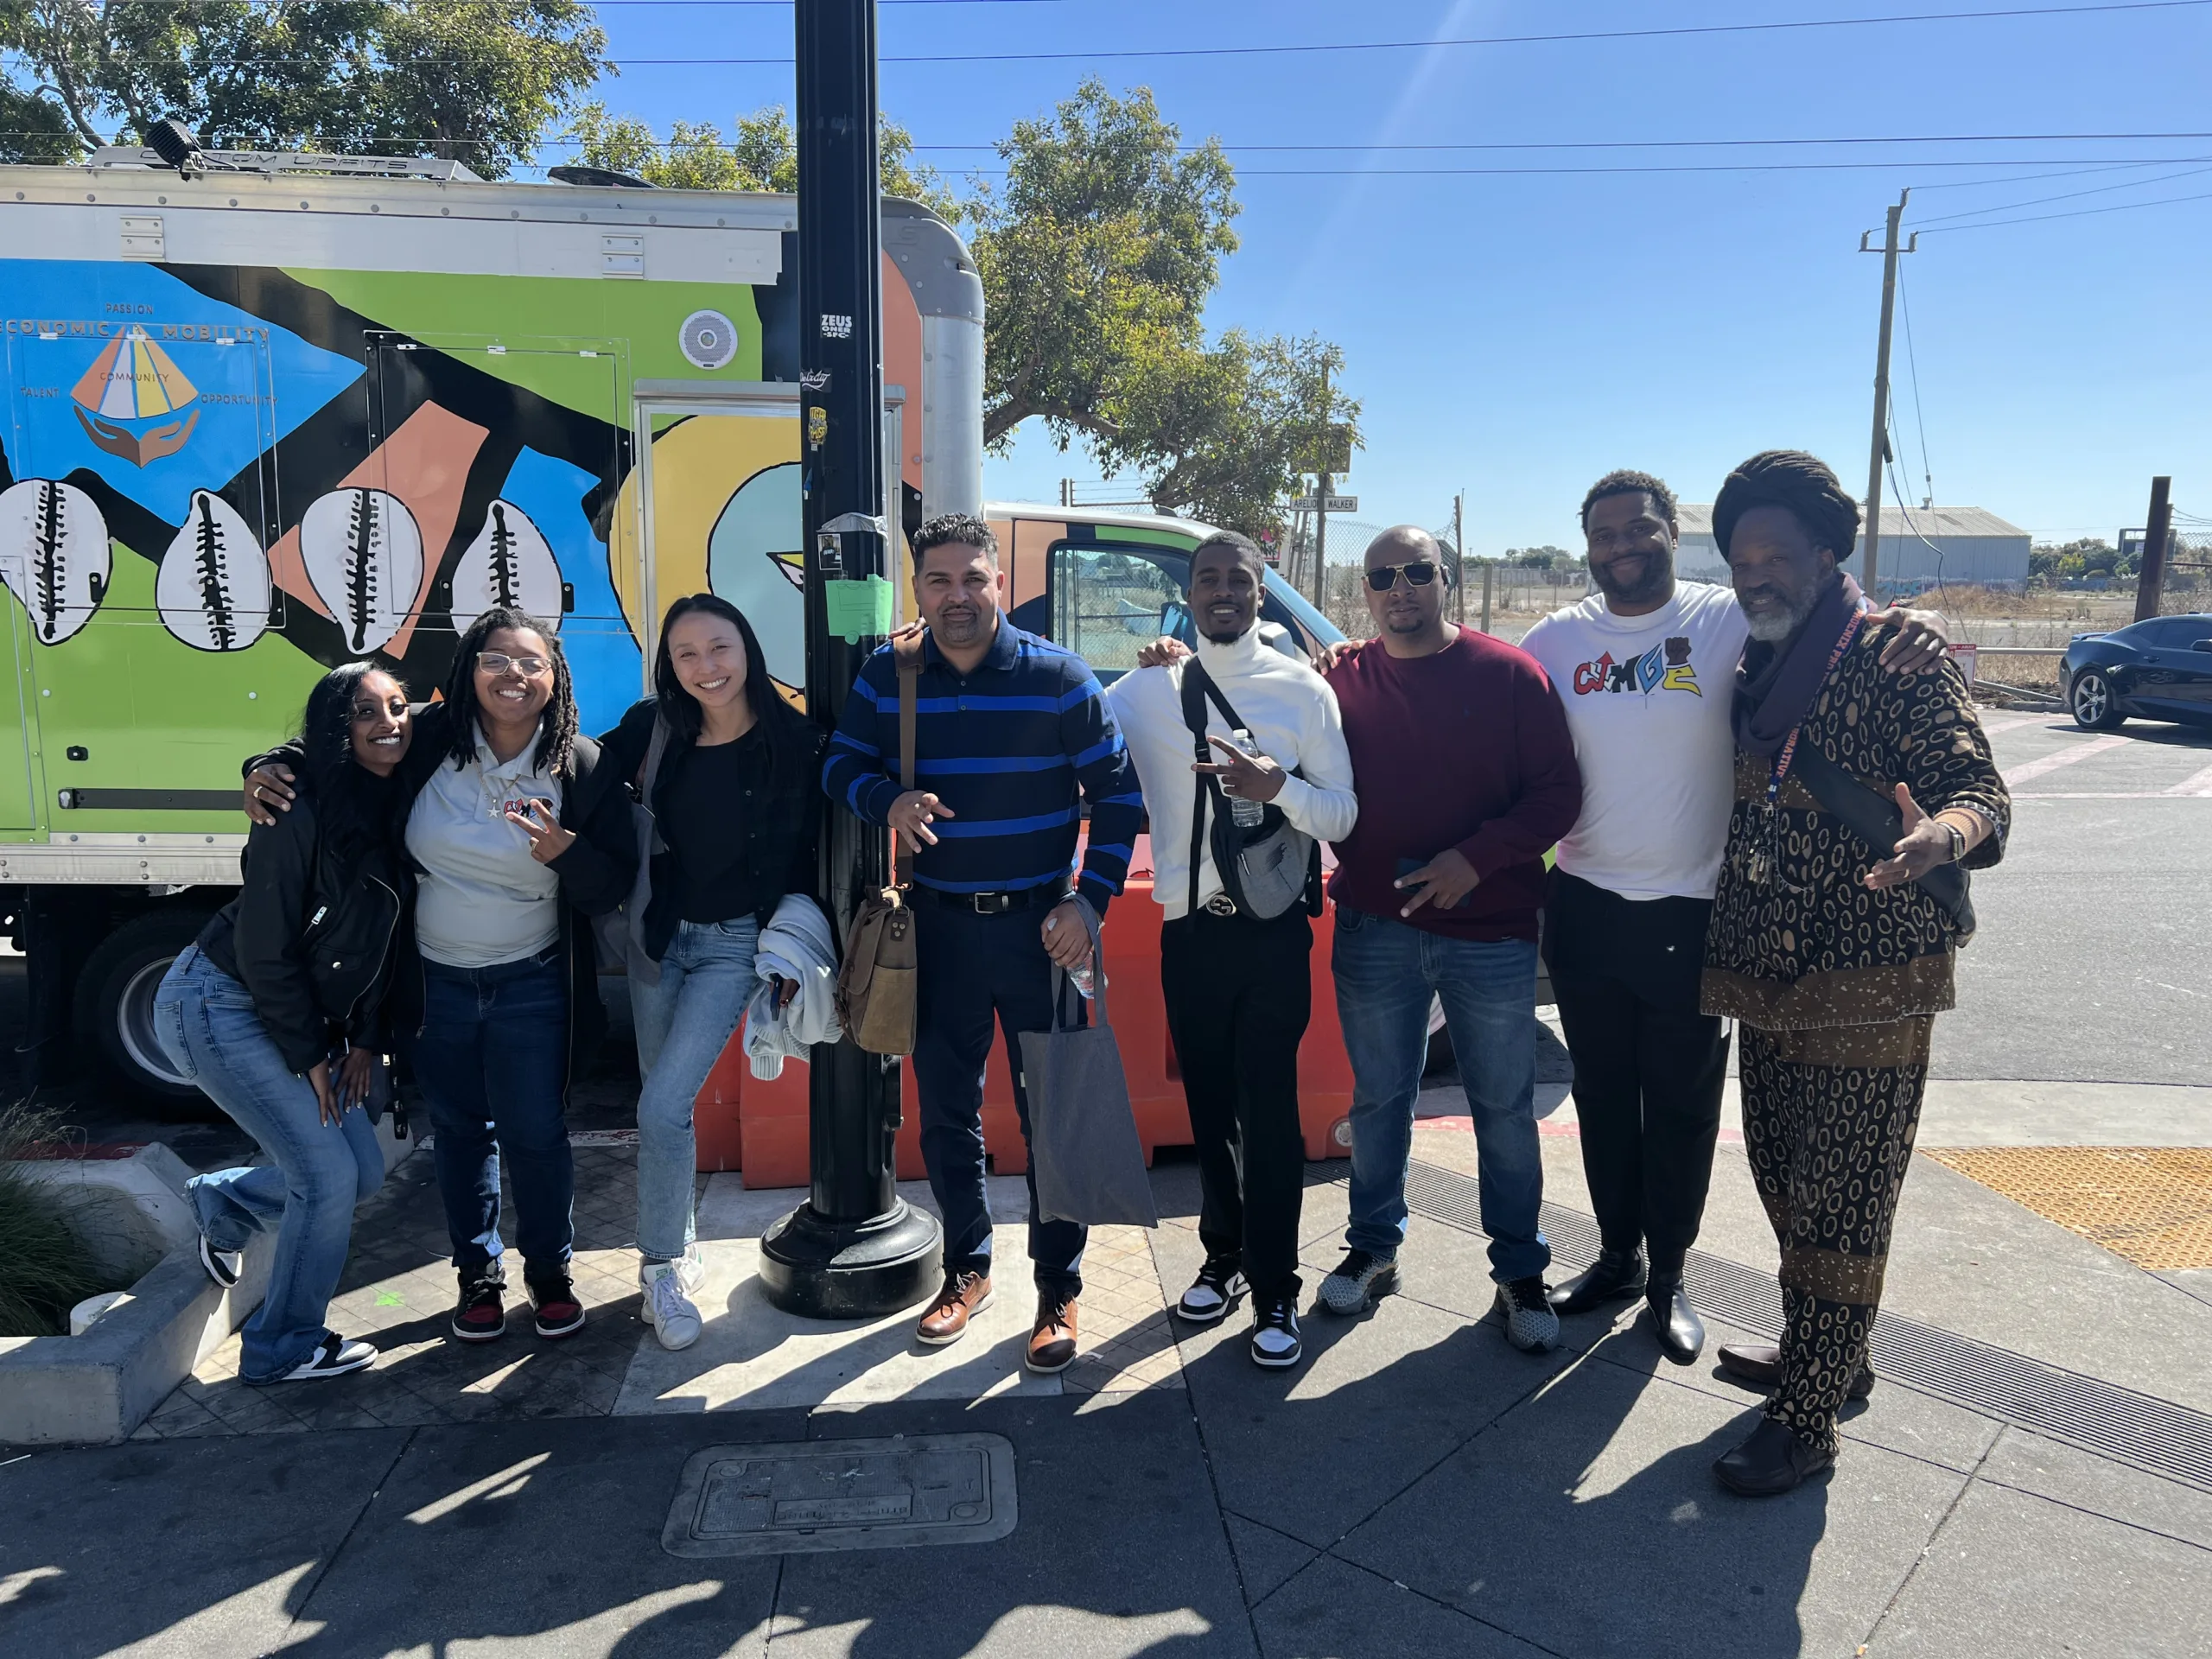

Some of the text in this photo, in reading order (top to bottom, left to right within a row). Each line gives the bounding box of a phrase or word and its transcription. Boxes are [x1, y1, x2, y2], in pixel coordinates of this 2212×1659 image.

[140, 150, 277, 164] CTOM
[105, 302, 154, 315] PASSION
[821, 314, 853, 328] ZEUS
[0, 320, 270, 343] CONOMIC MOBILITY
[821, 325, 851, 334] ONER
[99, 372, 169, 383] COMMUNITY
[20, 387, 60, 397] TALENT
[1294, 499, 1353, 509] ARELIO WALKER
